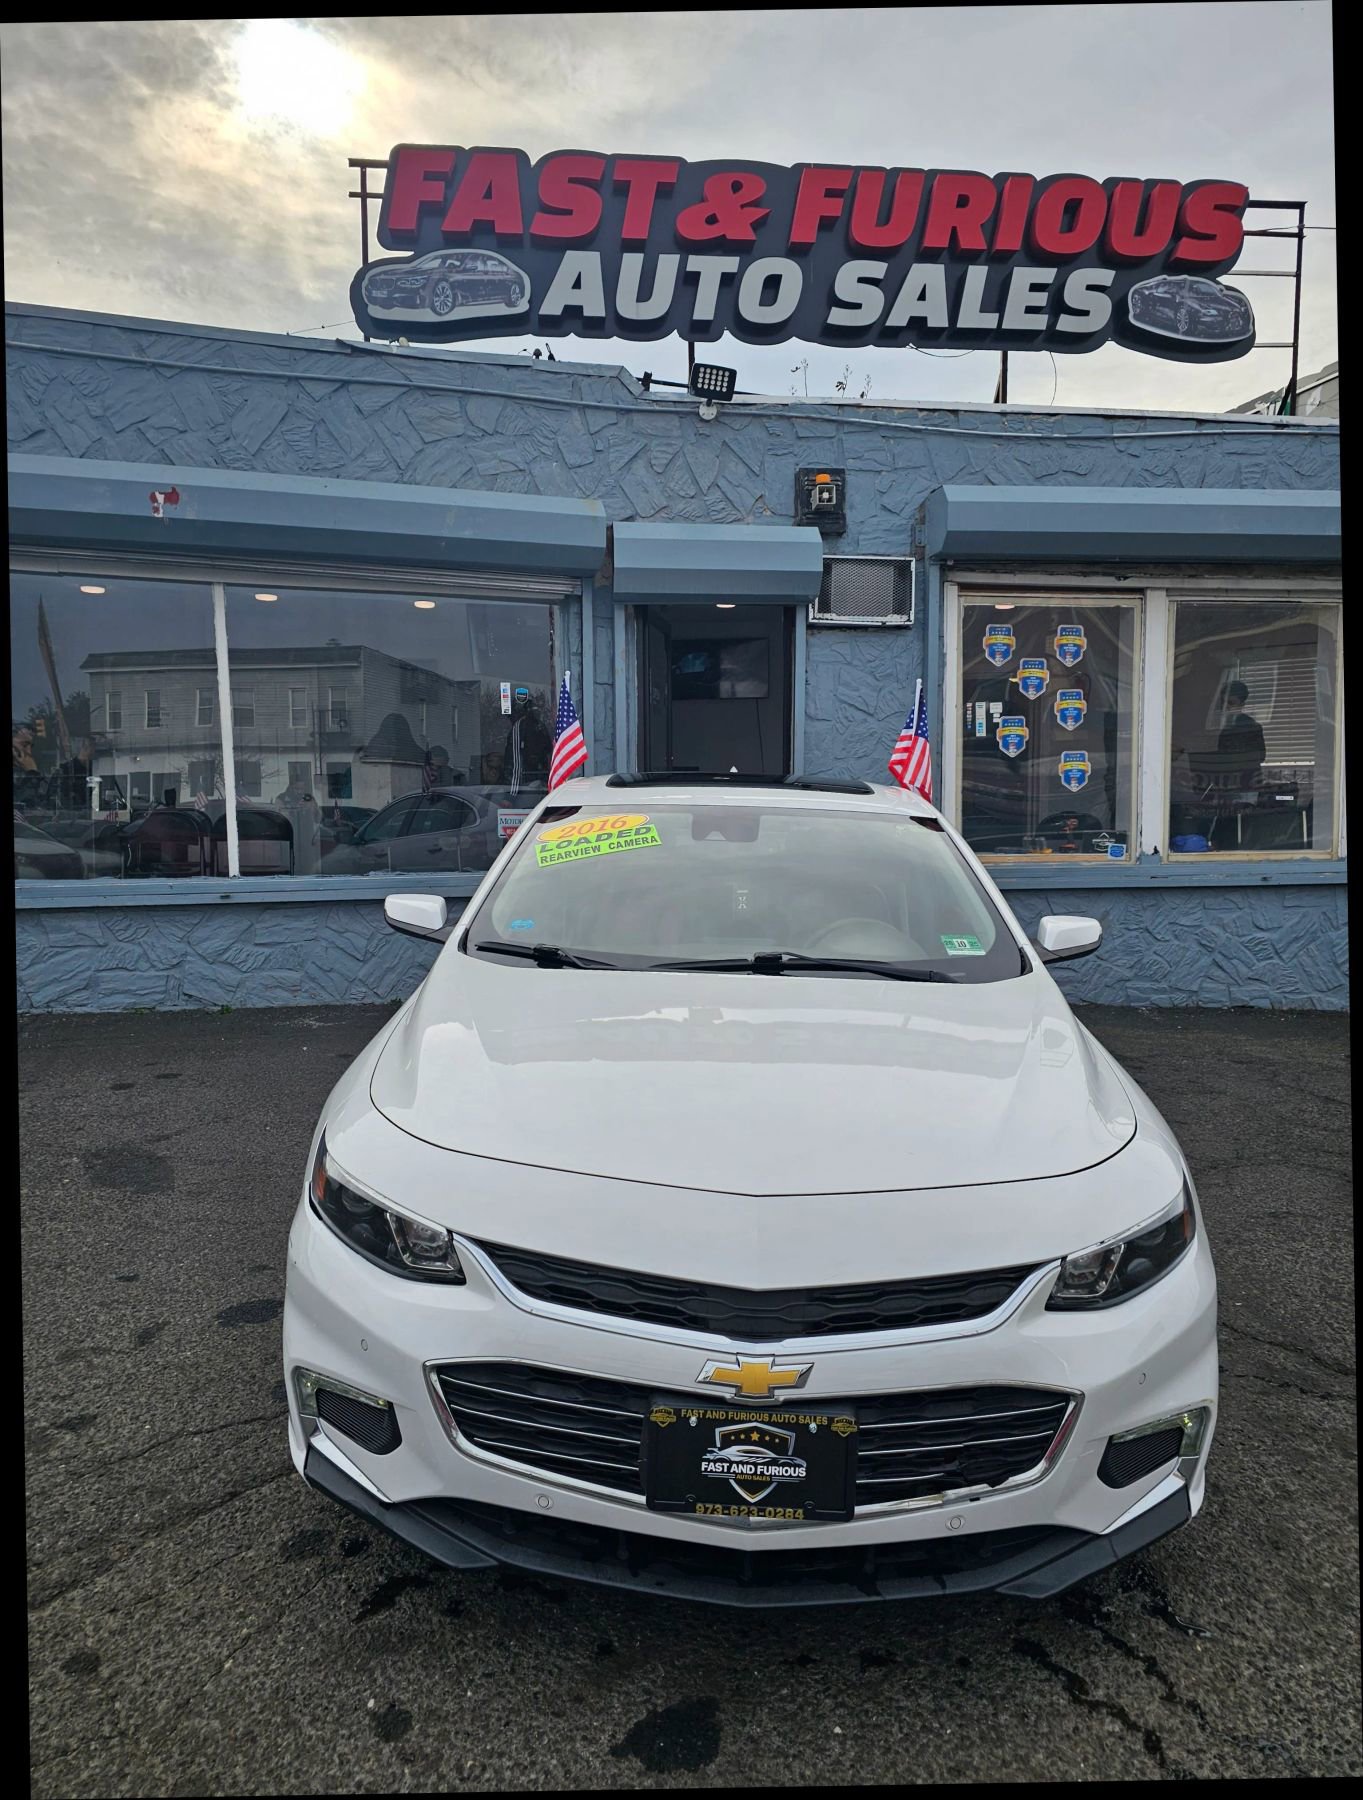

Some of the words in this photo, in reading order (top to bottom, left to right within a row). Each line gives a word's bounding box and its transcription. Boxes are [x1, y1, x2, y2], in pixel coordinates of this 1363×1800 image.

[388, 149, 680, 244] FAST
[675, 171, 772, 244] &
[788, 167, 1249, 265] FURIOUS
[537, 250, 803, 325] AUTO
[826, 259, 1117, 334] SALES
[539, 826, 652, 853] LOADED
[558, 815, 628, 839] 2016
[540, 844, 601, 864] REARVIEW
[608, 835, 659, 851] CAMERA
[681, 1408, 703, 1419] FAST
[705, 1410, 726, 1420] AND
[728, 1411, 769, 1422] FURIOUS
[771, 1414, 797, 1424] AUTO
[798, 1415, 828, 1425] SALES
[701, 1461, 730, 1473] FAST
[730, 1463, 756, 1475] AND
[756, 1465, 807, 1477] FURIOUS
[695, 1503, 805, 1521] 973-623-0284
